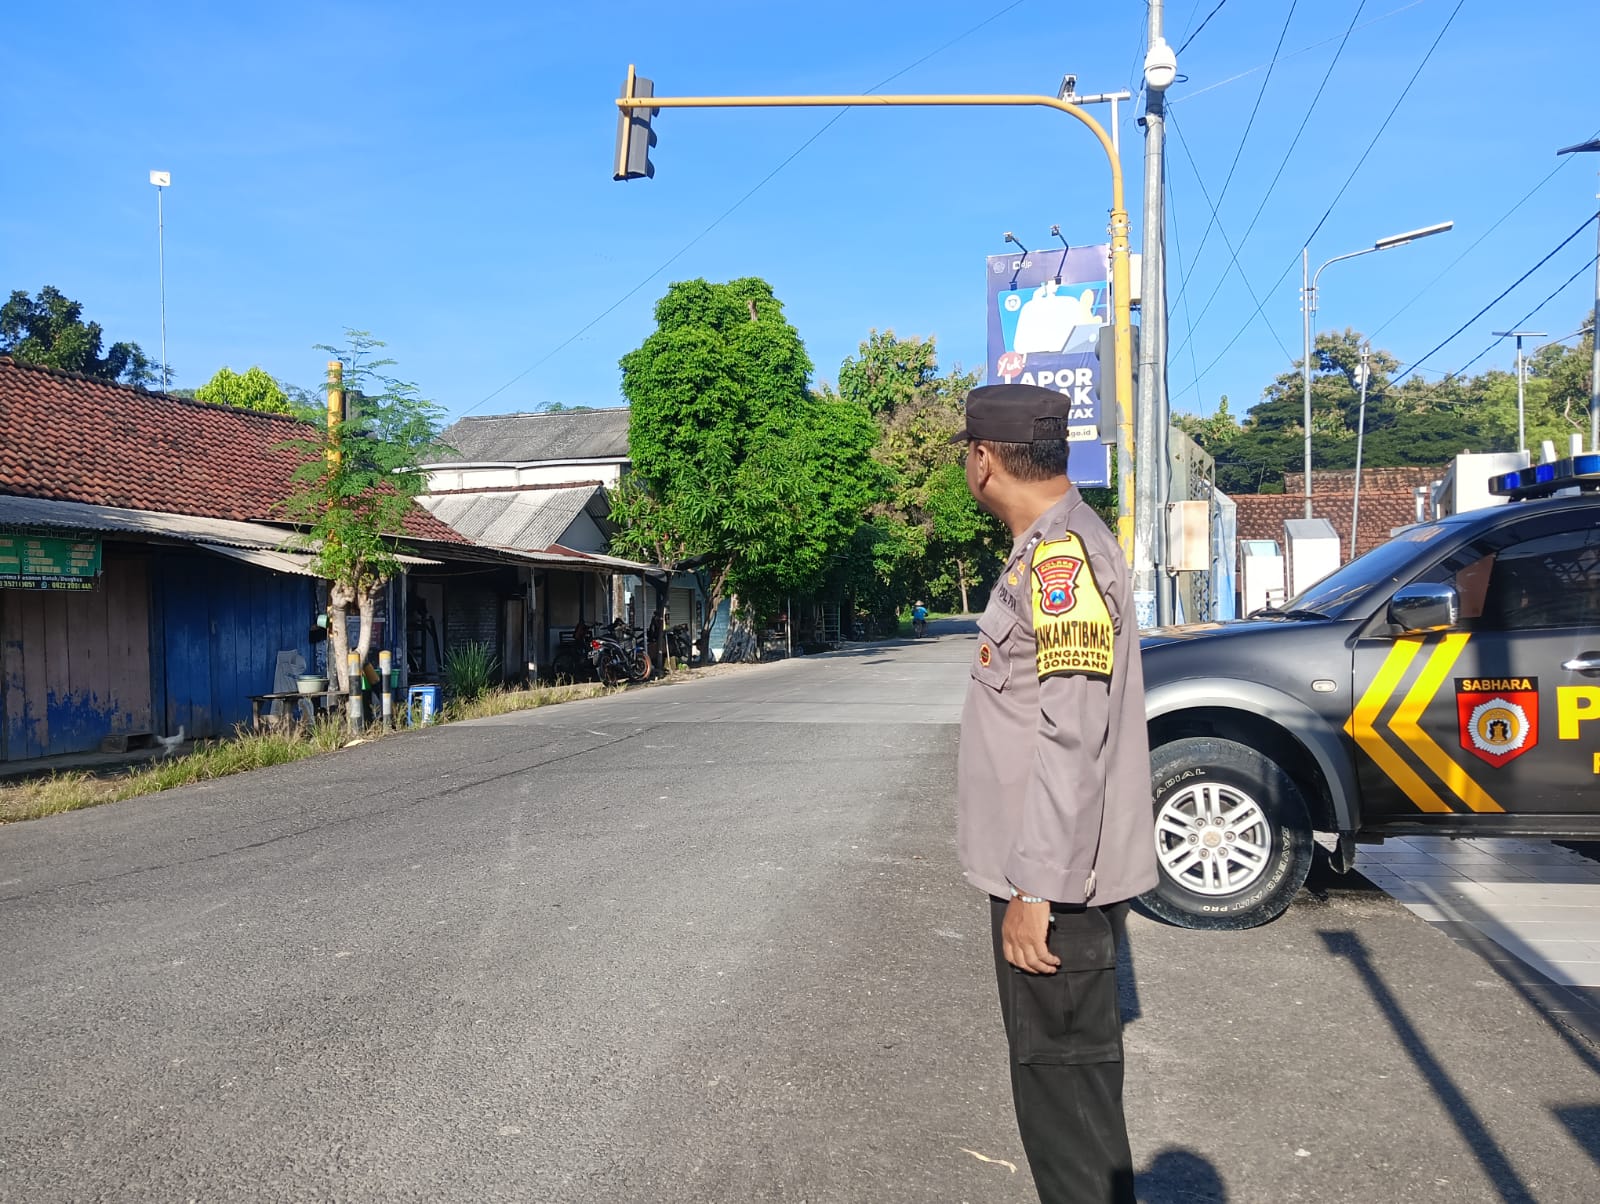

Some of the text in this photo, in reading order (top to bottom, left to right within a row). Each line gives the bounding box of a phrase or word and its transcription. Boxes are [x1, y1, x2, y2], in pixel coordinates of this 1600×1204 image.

[1043, 650, 1108, 661] SENGANTEN
[1044, 658, 1107, 670] GONDANG
[1462, 679, 1532, 691] SABHARA
